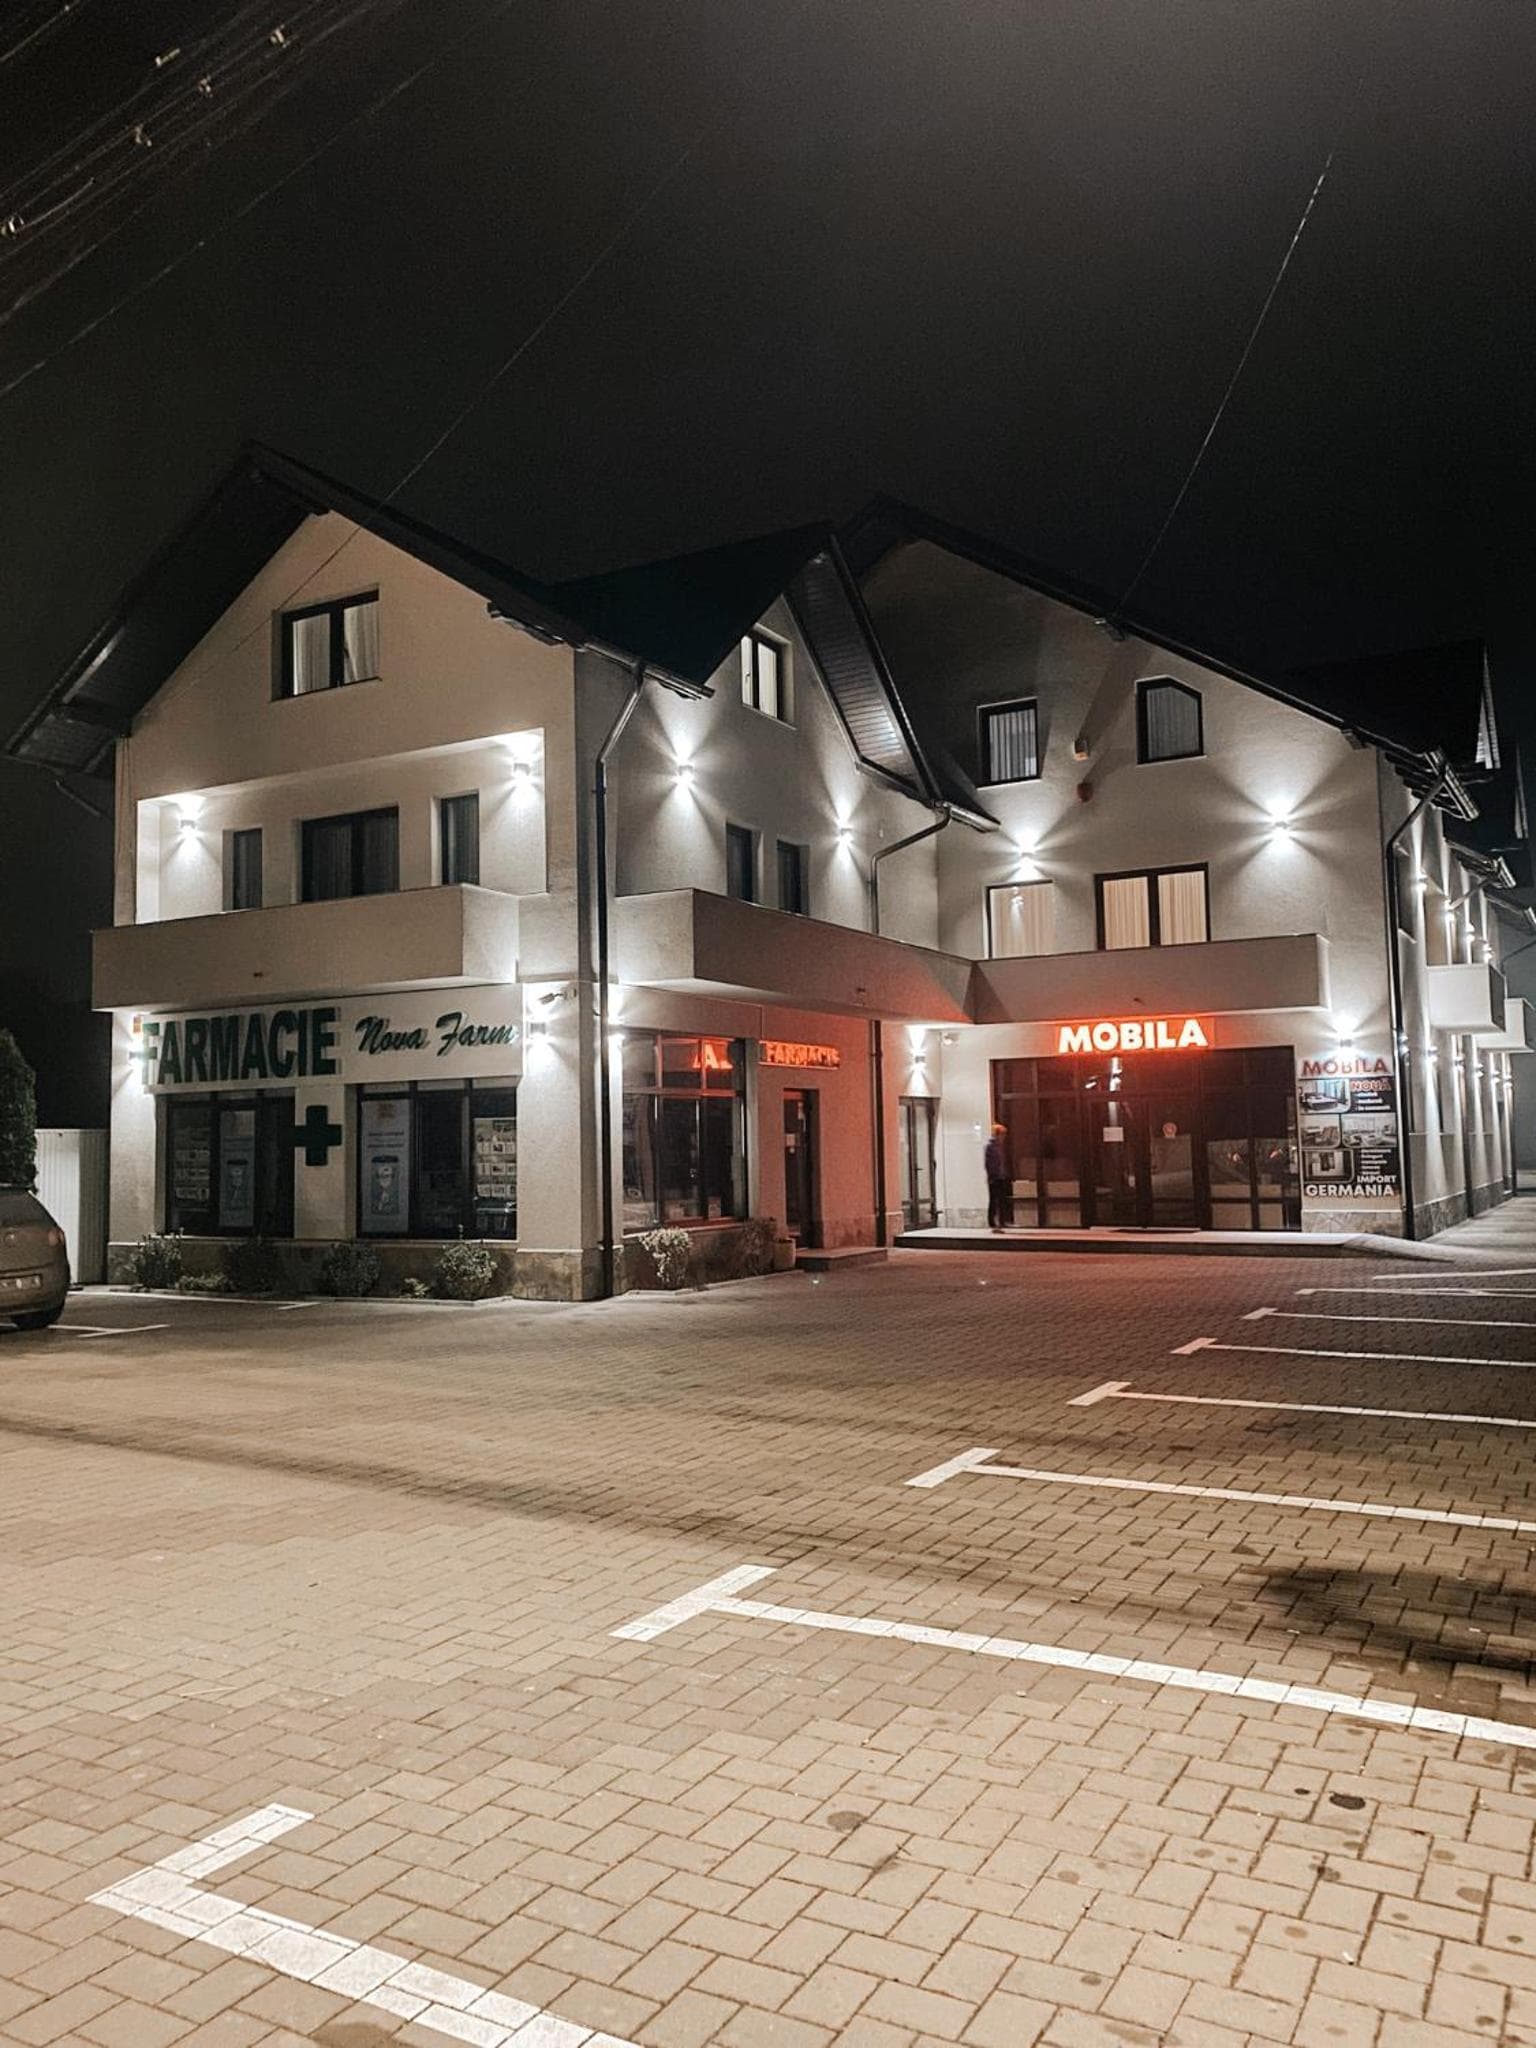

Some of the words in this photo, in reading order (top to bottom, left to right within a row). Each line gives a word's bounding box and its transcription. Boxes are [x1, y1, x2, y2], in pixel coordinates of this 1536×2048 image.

[143, 1006, 338, 1084] FARMACIE
[355, 1015, 427, 1055] Nova
[435, 1011, 516, 1056] Farm
[1058, 1018, 1208, 1054] MOBILA
[764, 1041, 841, 1067] FARMACIE
[1301, 1057, 1389, 1077] MOBILA
[1305, 1184, 1395, 1198] GERMANIA
[1357, 1174, 1397, 1184] IMPORT
